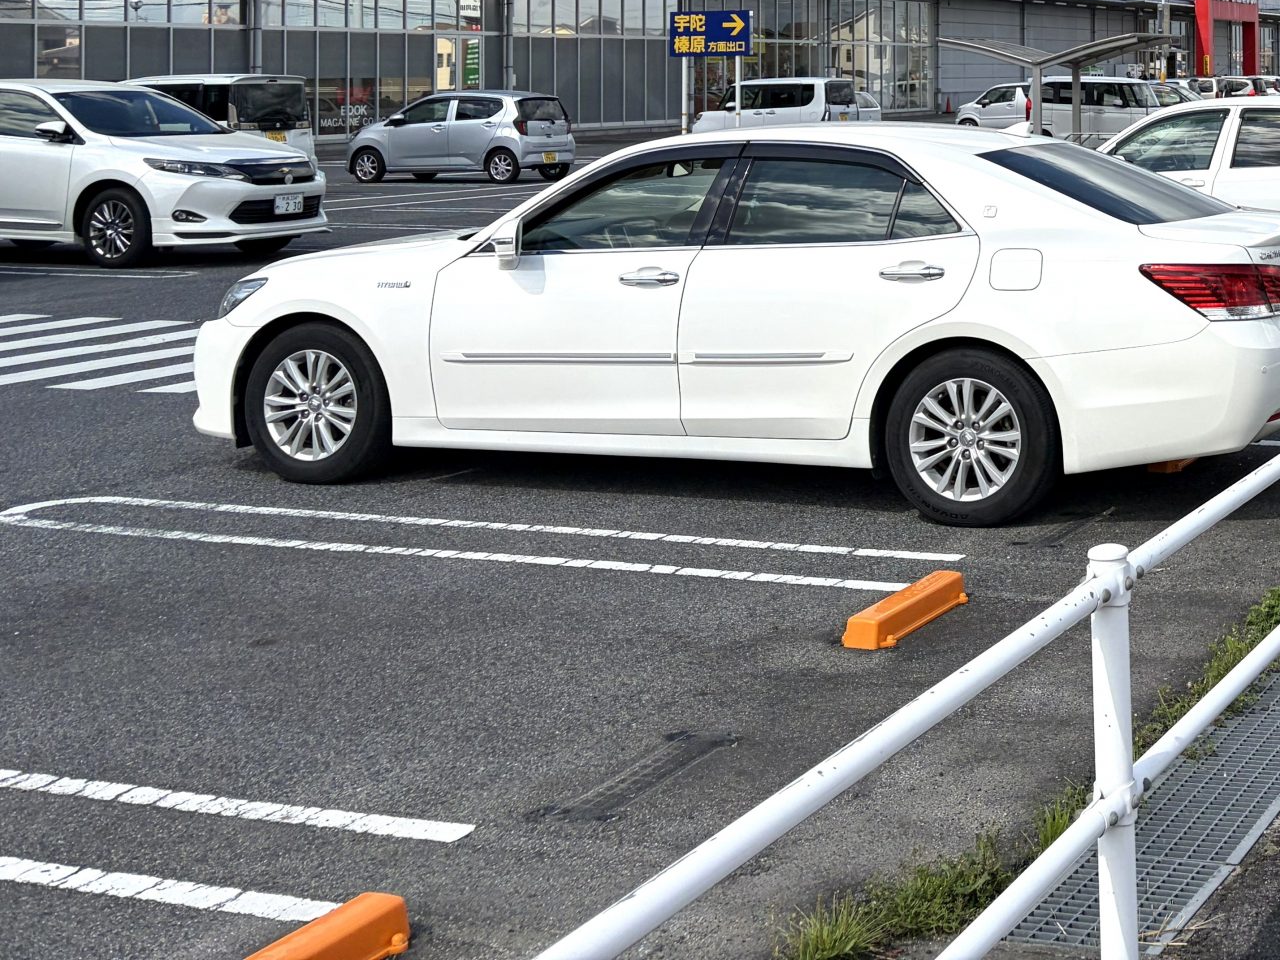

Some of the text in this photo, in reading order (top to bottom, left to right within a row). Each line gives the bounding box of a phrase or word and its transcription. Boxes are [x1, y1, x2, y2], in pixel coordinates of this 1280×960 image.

[674, 14, 705, 32] 宇陀
[674, 35, 745, 54] 榛原 方面出口
